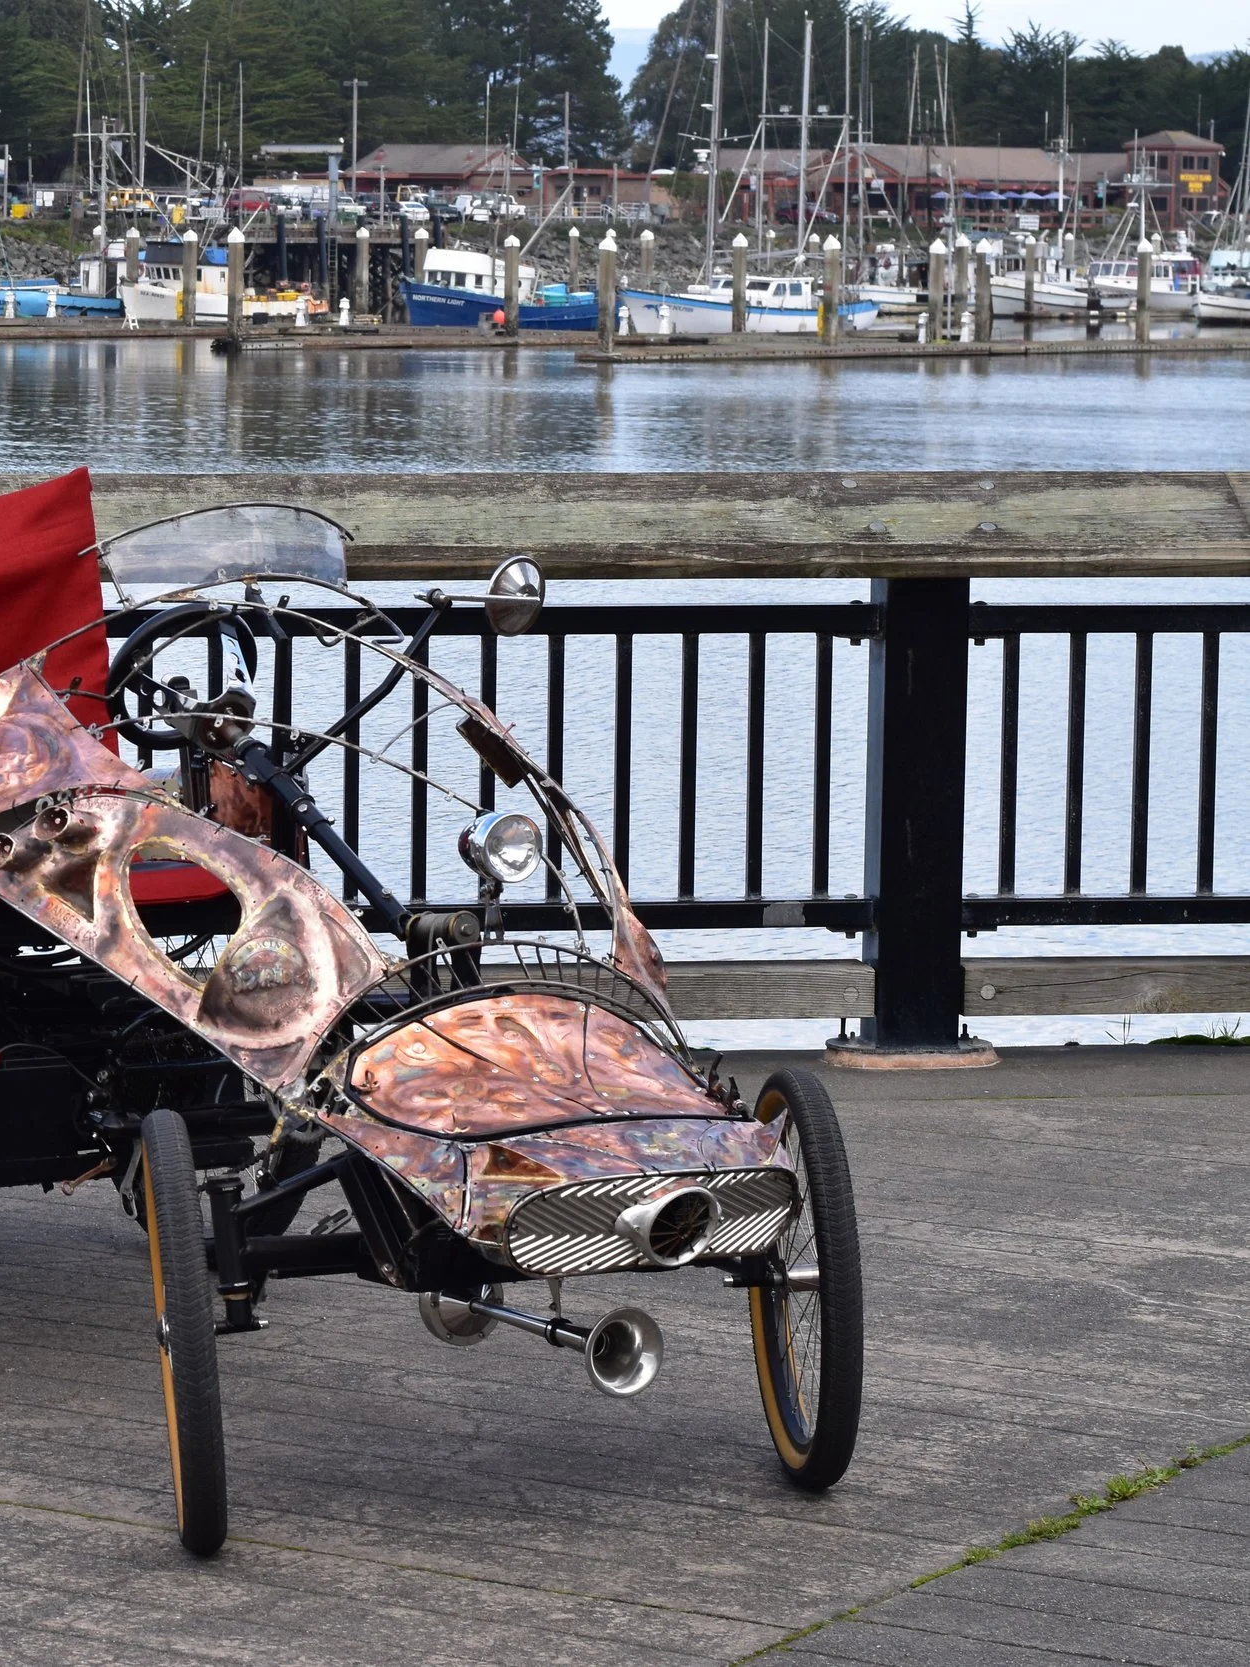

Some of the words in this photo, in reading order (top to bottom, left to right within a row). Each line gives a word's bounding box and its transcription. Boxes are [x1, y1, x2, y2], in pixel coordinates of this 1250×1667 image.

[412, 294, 445, 303] NORTHERN
[447, 298, 465, 306] LIGHT
[46, 900, 81, 929] DANGER
[246, 940, 289, 953] RACING
